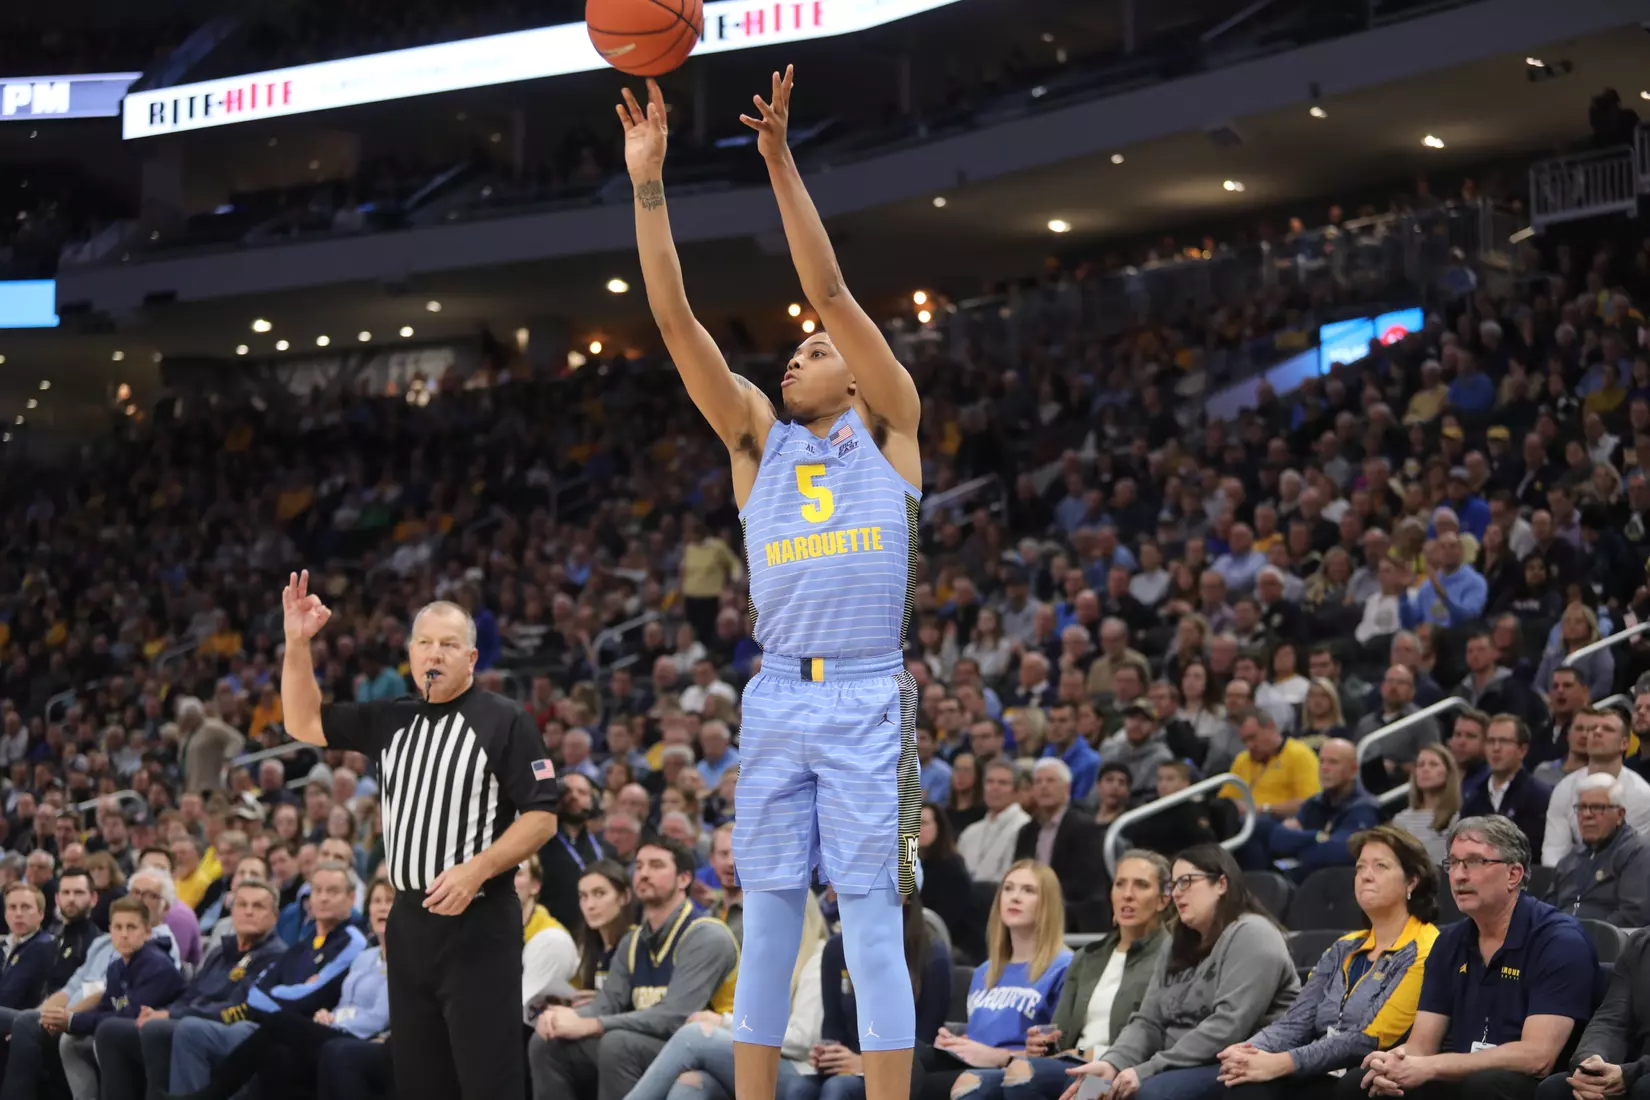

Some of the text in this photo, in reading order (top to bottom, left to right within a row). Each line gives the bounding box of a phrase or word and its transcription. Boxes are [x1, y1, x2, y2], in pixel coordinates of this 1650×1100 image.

[700, 1, 823, 42] TE-HITE
[2, 81, 71, 116] PM
[149, 81, 293, 126] RITE-HITE
[795, 463, 835, 524] 5
[765, 526, 884, 567] MARQUETTE
